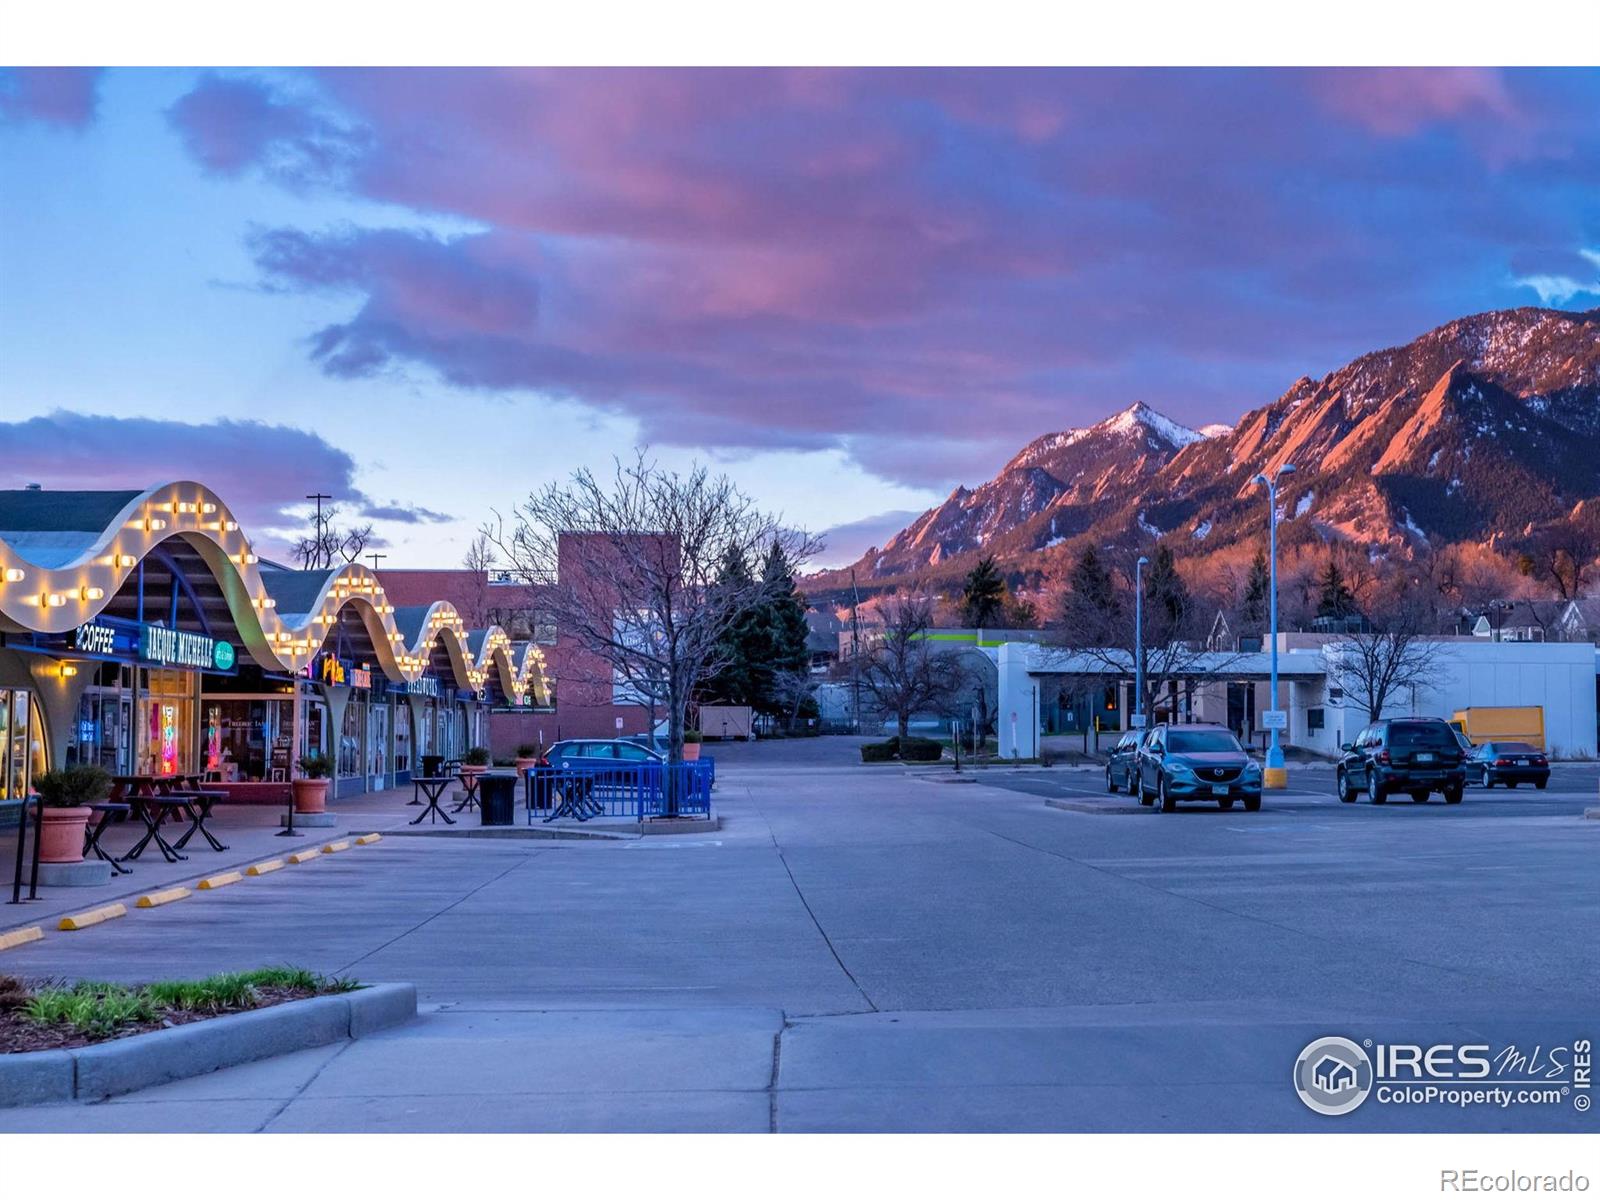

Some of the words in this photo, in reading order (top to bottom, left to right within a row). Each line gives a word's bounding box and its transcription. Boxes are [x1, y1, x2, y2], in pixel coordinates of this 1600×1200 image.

[82, 624, 115, 654] COFFEE
[146, 626, 177, 666] JACQUE
[177, 632, 213, 669] MICHELLE
